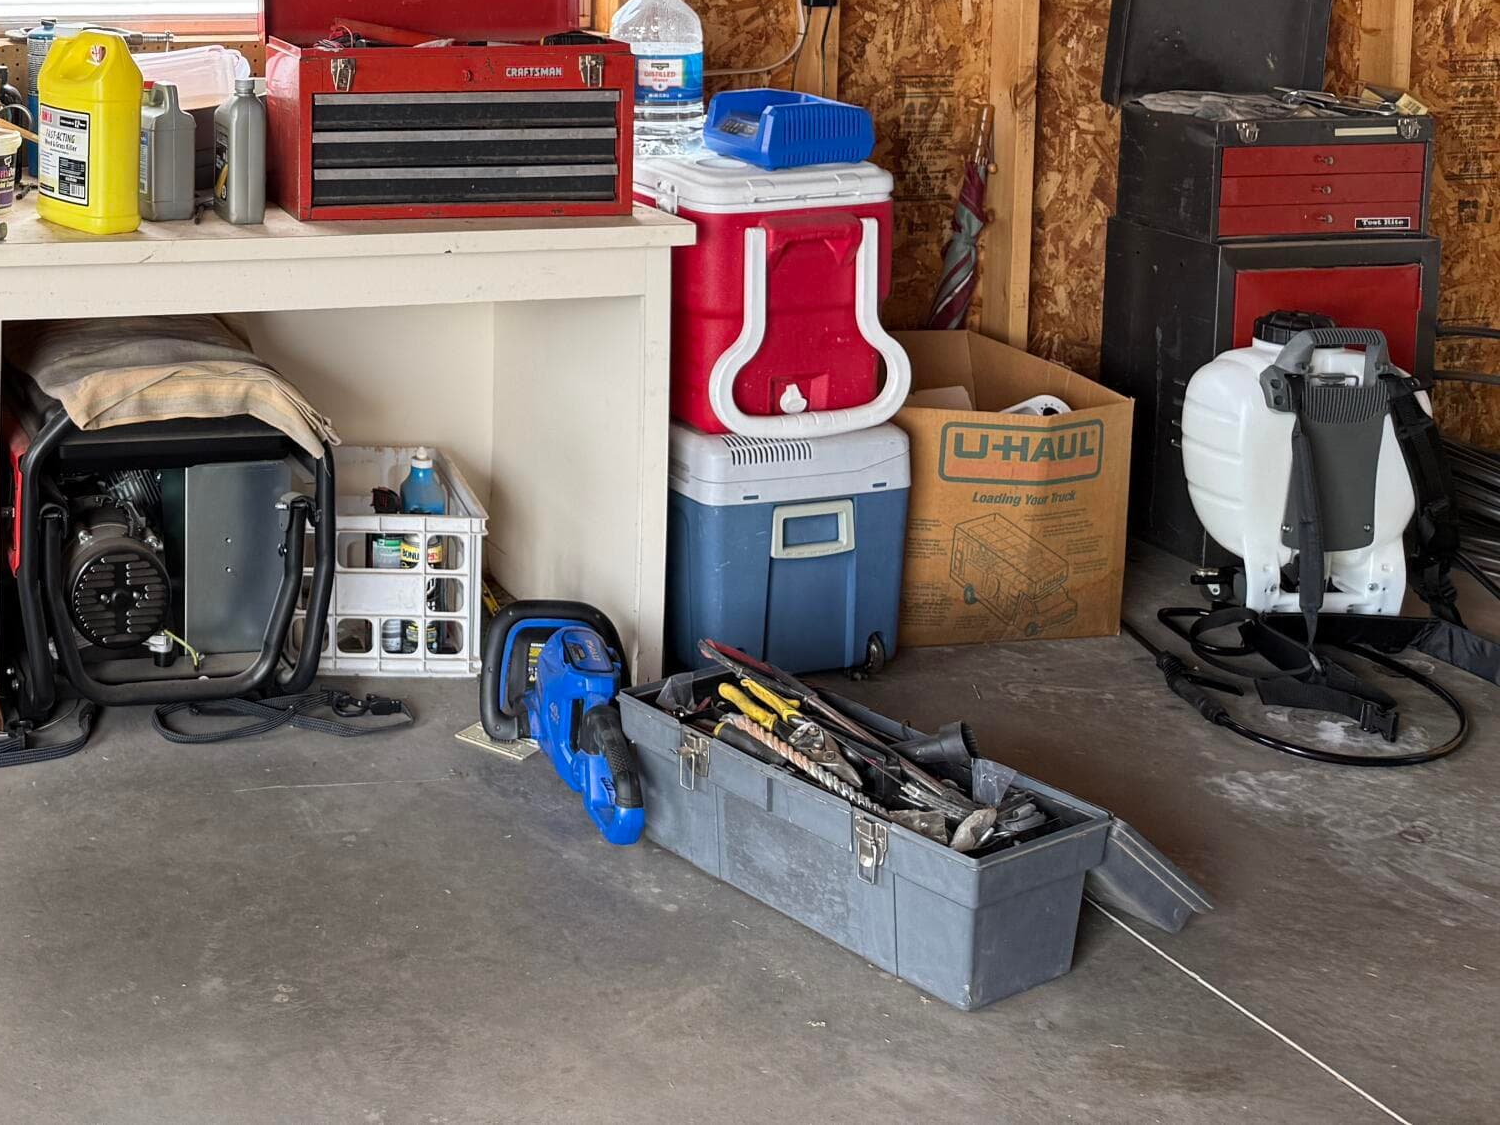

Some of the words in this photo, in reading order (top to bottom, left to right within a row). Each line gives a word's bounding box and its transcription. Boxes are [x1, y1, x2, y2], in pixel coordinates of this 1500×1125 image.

[505, 66, 564, 77] CRAFTSMAN
[953, 431, 1095, 462] U-HAUL
[972, 491, 1022, 507] Loading
[1025, 494, 1049, 505] Your
[1051, 489, 1077, 504] Truck
[402, 549, 420, 561] BONU
